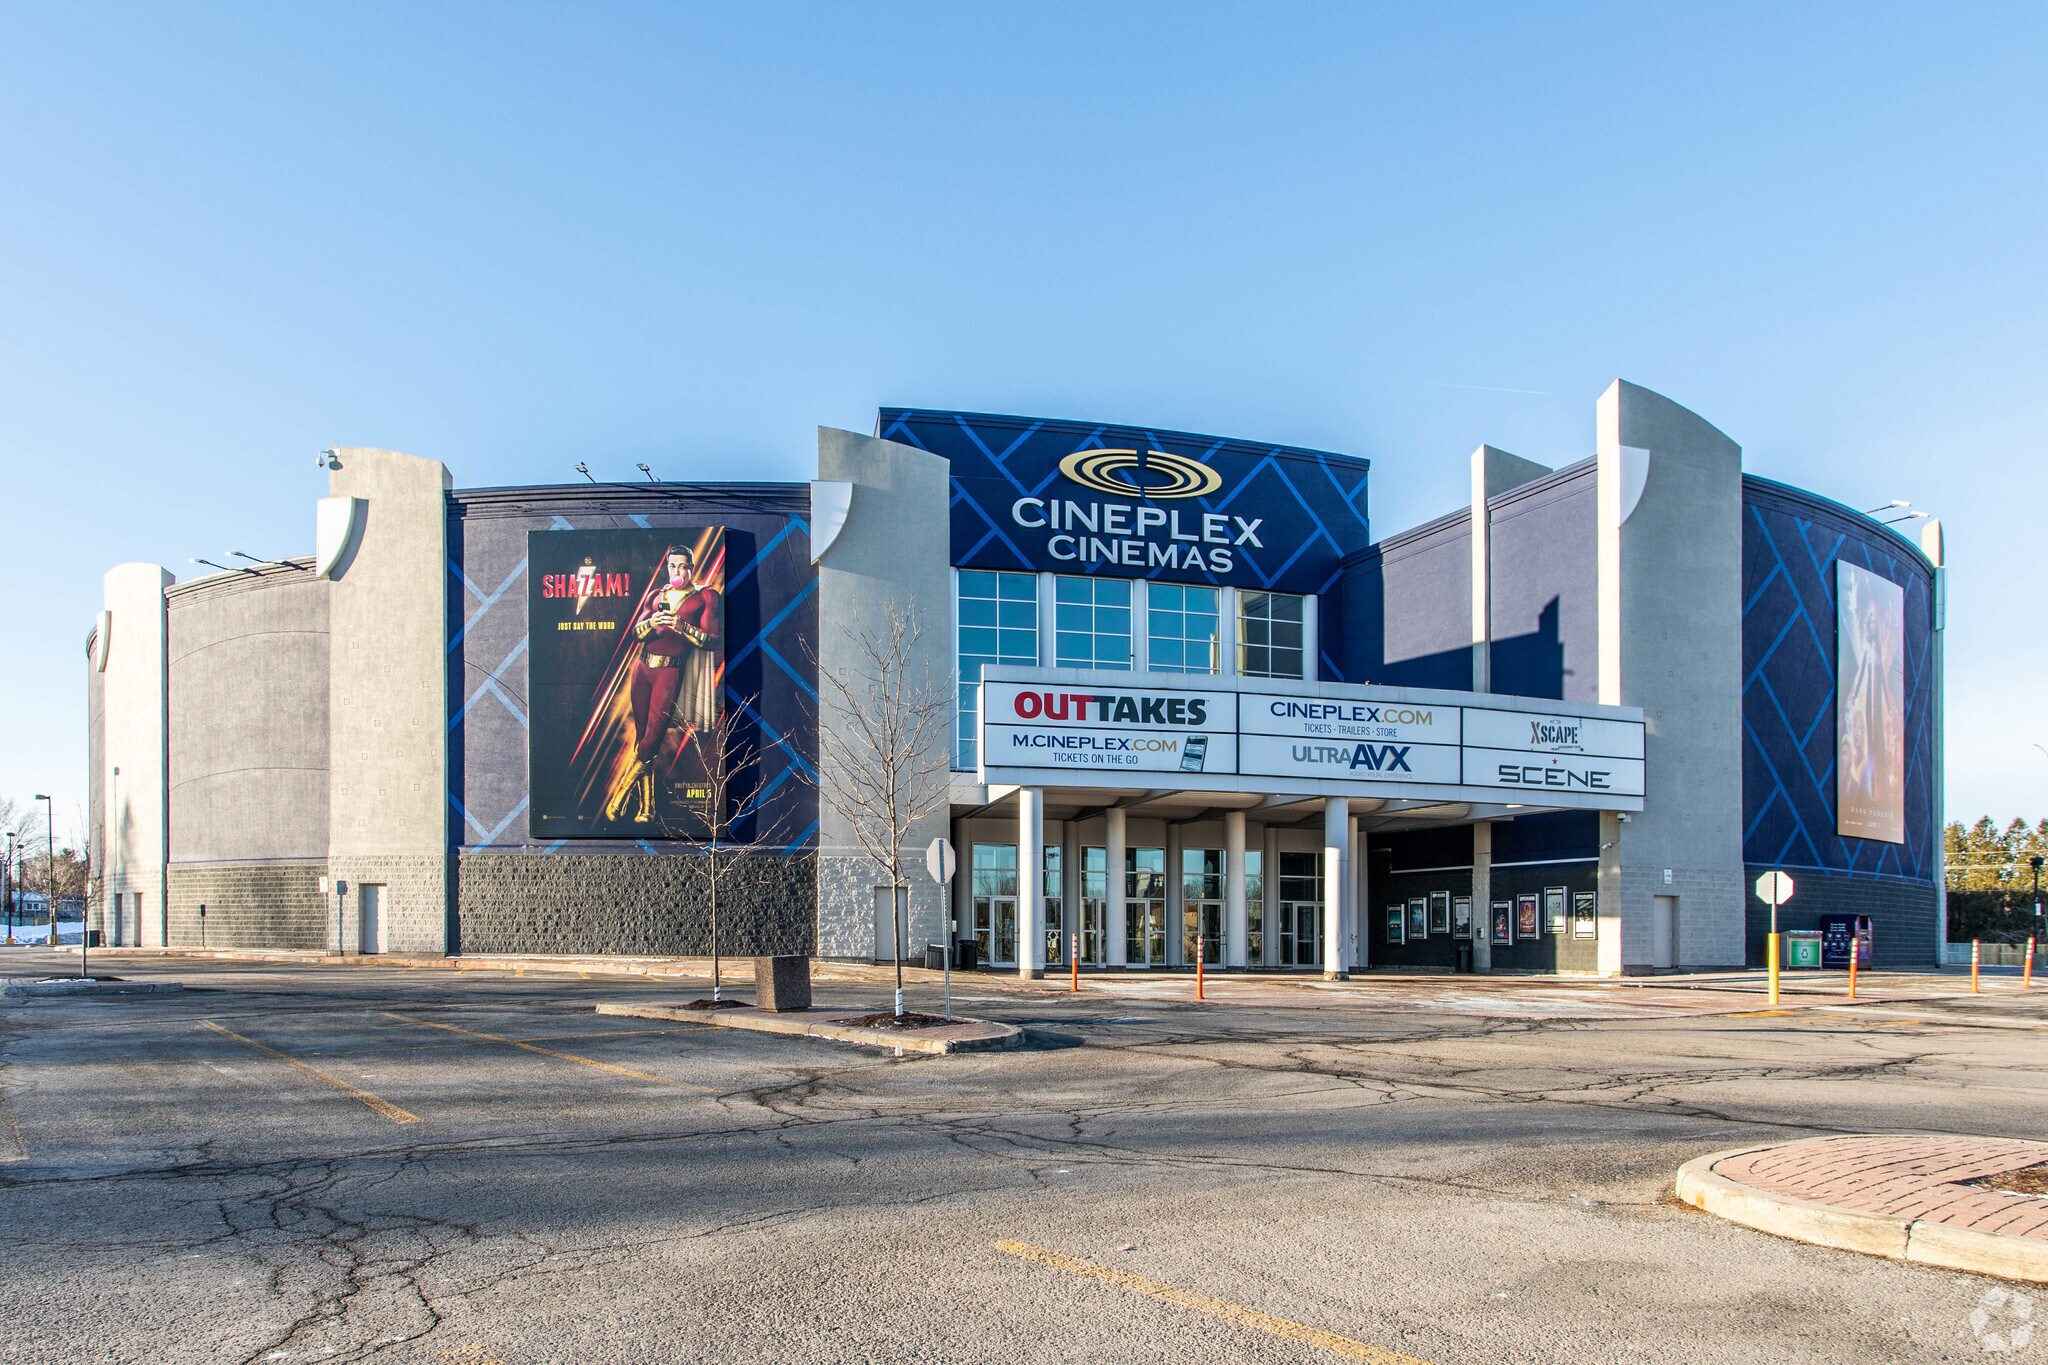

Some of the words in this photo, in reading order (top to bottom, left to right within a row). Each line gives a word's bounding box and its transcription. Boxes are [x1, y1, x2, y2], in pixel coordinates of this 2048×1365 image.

[1011, 496, 1264, 548] CINEPLEX
[1047, 534, 1234, 573] CINEMAS
[542, 573, 630, 599] SHAZAM!
[558, 622, 572, 631] JUST
[573, 622, 585, 631] SAY
[585, 621, 597, 630] THE
[597, 621, 615, 630] WORD
[1014, 691, 1207, 726] OUTTAKES
[1270, 701, 1433, 726] CINEPLEX.COM
[1304, 723, 1332, 734] TICKETS
[1338, 725, 1370, 736] TRAILERS
[1376, 727, 1398, 738] STORE
[1530, 721, 1578, 745] XSCAPE
[1013, 734, 1177, 752] M.CINEPLEX.COM
[1053, 752, 1089, 763] TICKETS
[1091, 754, 1104, 764] ON
[1107, 754, 1123, 764] THE
[1126, 755, 1139, 765] GO
[1384, 772, 1413, 780] EXPERIENCE
[1498, 765, 1611, 789] SCENE
[686, 789, 706, 798] APRIL
[706, 789, 712, 798] 5
